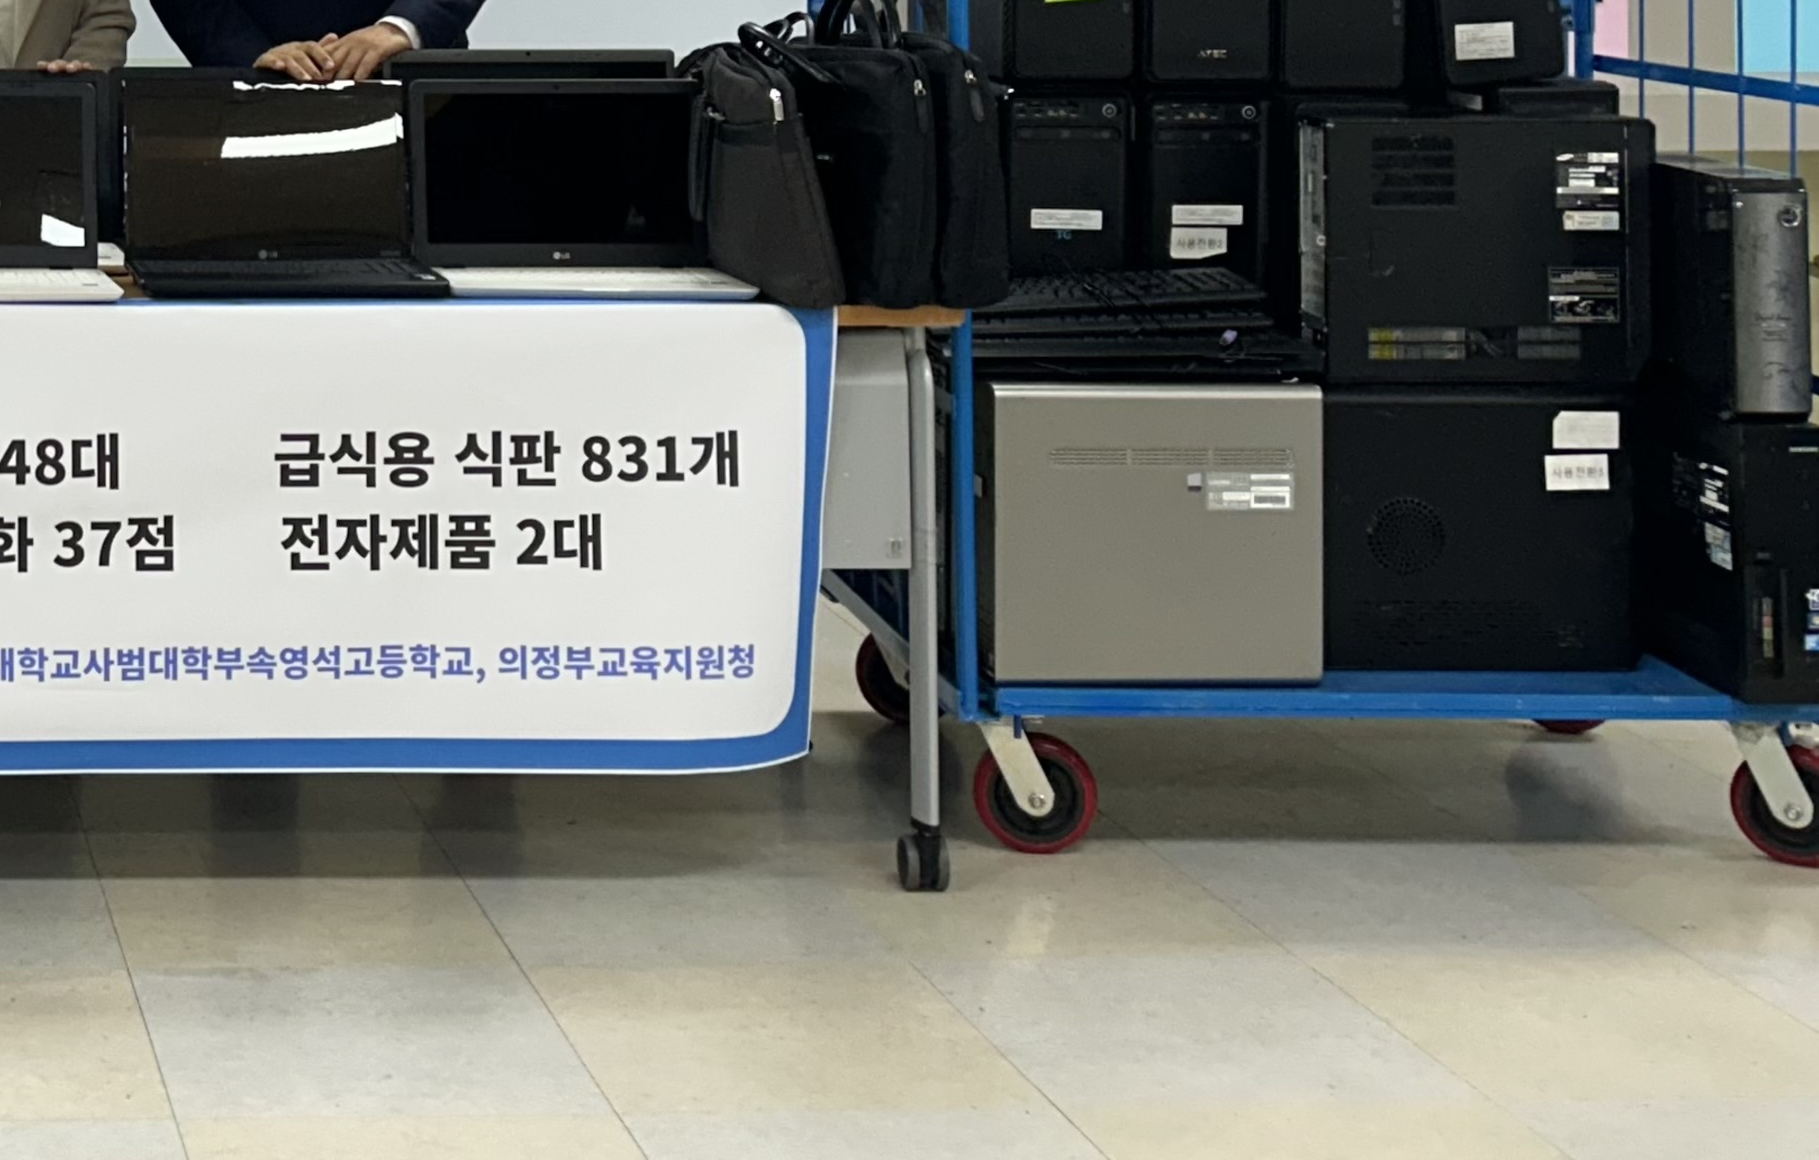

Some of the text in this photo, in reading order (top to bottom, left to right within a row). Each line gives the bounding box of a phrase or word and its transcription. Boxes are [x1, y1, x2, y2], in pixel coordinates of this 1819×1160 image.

[274, 430, 740, 488] 급식용 식판 831개
[53, 514, 175, 572] 37점
[281, 513, 603, 571] 전자제품 2대
[498, 643, 755, 681] 의정부교육지원청
